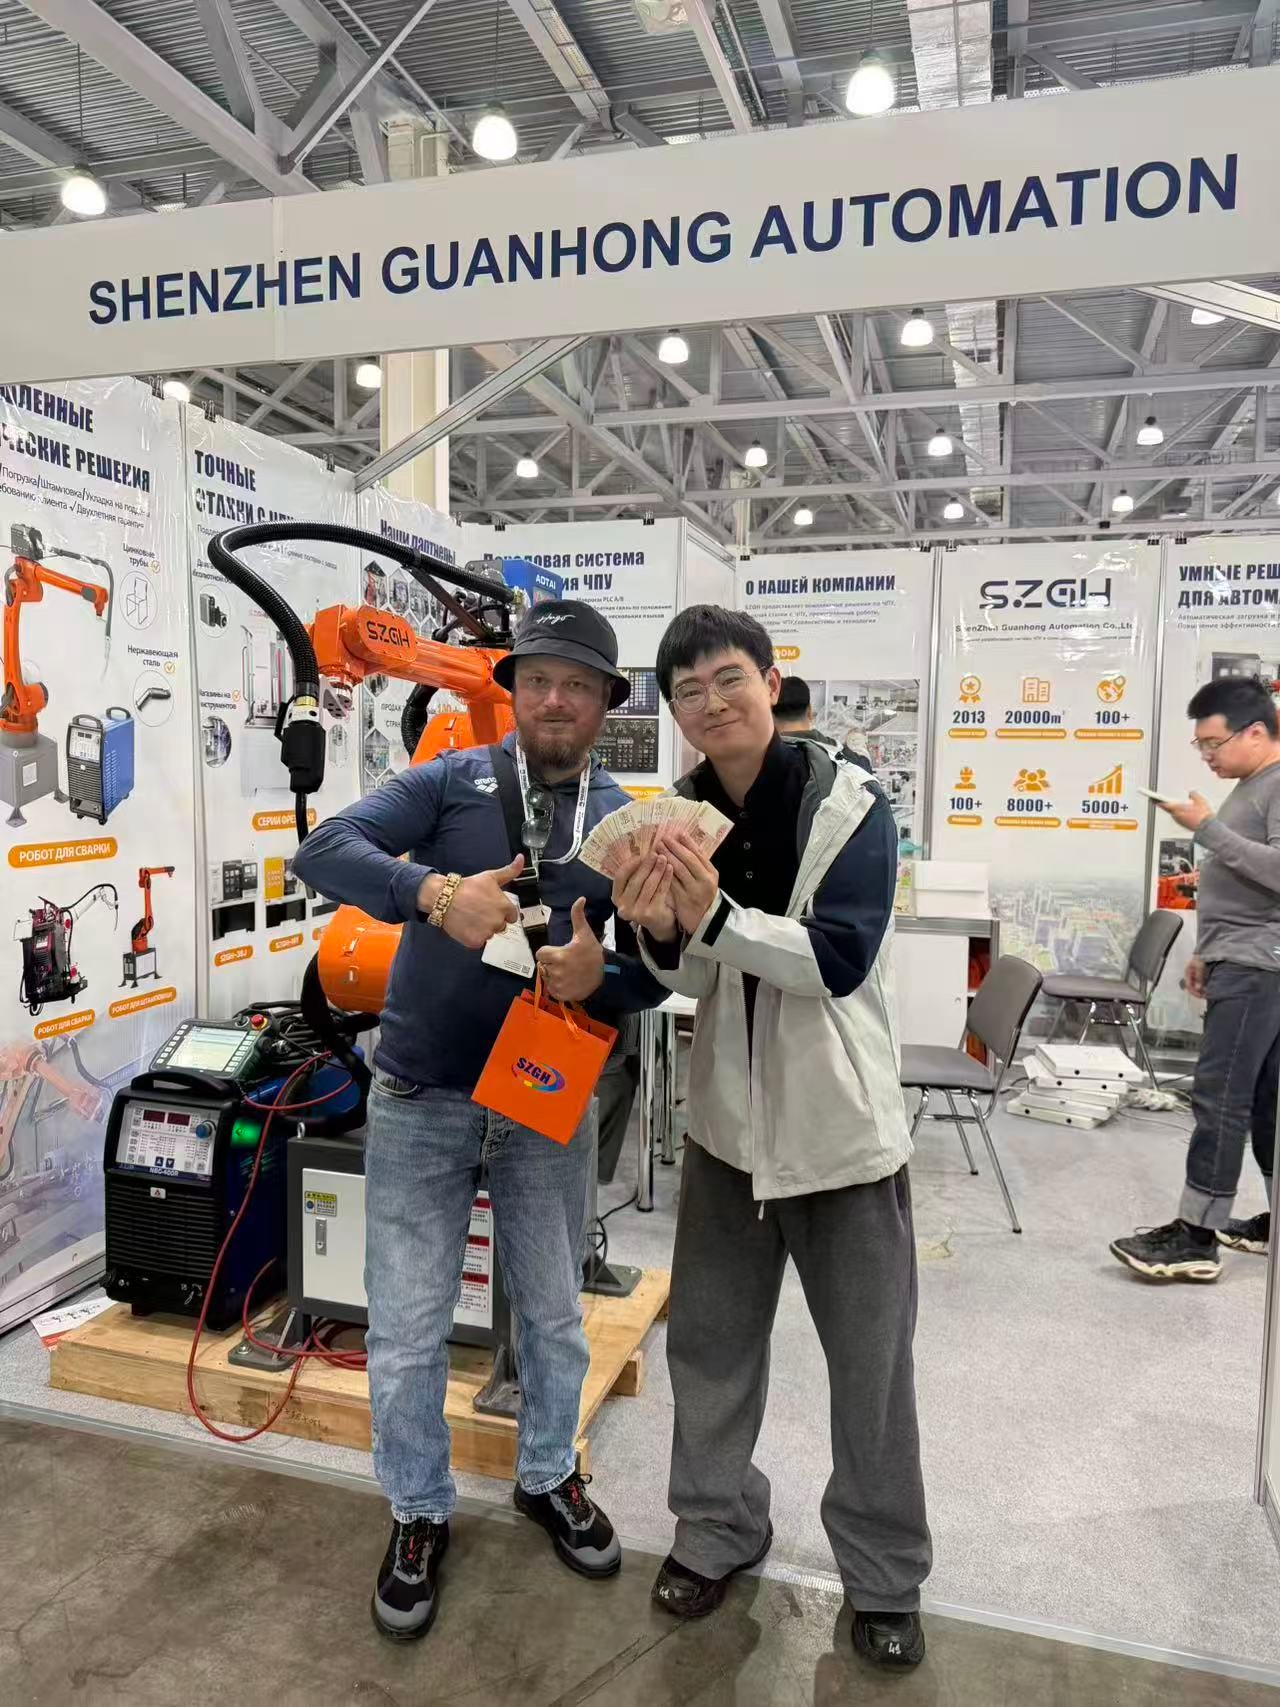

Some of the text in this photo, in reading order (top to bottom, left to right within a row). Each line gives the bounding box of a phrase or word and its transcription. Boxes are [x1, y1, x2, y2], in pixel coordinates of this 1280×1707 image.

[88, 153, 1238, 325] SHENZHEN GUANHONG AUTOMATION
[194, 449, 256, 492] ТОЧНЫЕ
[380, 519, 410, 544] Наши
[574, 552, 645, 568] система
[583, 574, 613, 591] ЧПУ
[745, 575, 896, 596] О НАШЕЙ КОМПАНИИ
[1178, 590, 1214, 608] ДЛЯ
[366, 620, 410, 648] SZGH
[1001, 623, 1046, 633] Guanhong
[127, 645, 179, 659] Нержавеющая
[143, 658, 161, 667] сталь
[952, 710, 985, 724] 2013
[1095, 710, 1131, 724] 100+
[474, 776, 497, 786] arena
[949, 797, 983, 810] 100+
[1007, 798, 1053, 812] 8000+
[1081, 799, 1129, 814] 5000+
[19, 843, 111, 863] РОБОТ ДЛЯ СВАРКИ
[38, 1025, 58, 1035] РОБОТ
[516, 1057, 551, 1085] SZGH
